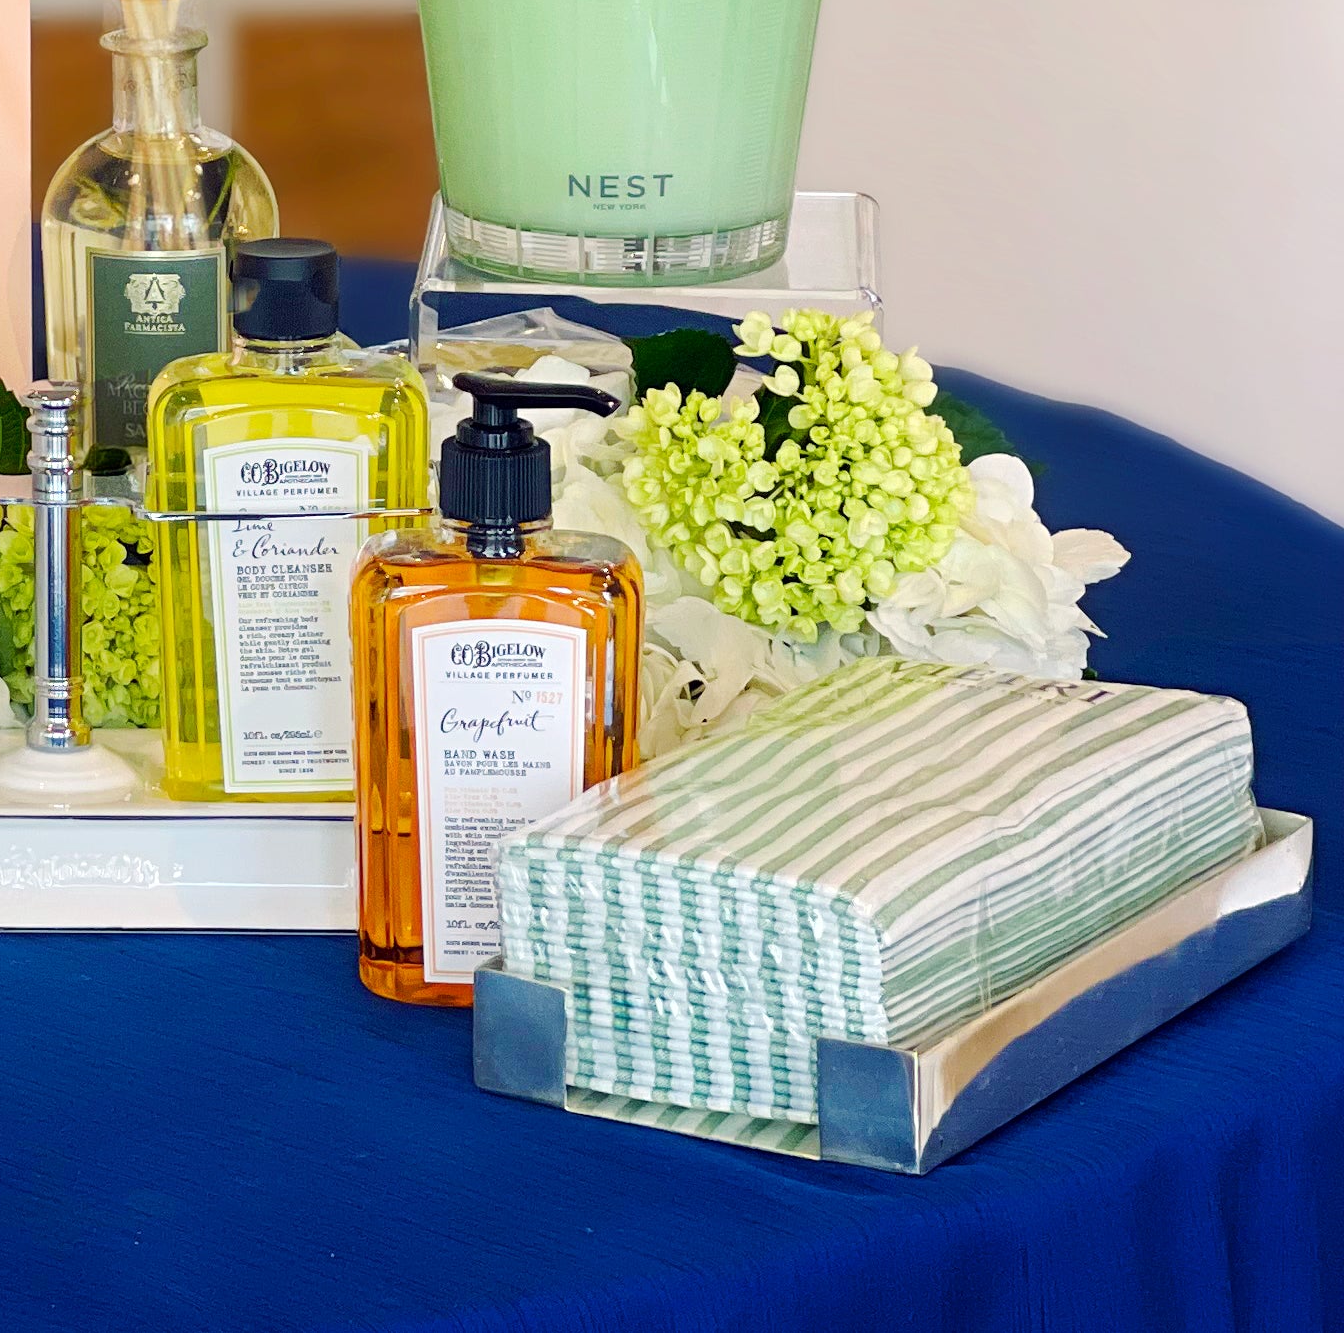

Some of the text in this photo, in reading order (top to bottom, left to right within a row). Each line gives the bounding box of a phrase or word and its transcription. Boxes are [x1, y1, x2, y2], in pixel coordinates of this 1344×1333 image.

[568, 174, 673, 198] NEST
[593, 203, 646, 211] NEW YORK
[135, 314, 174, 324] ANTICA
[124, 322, 186, 333] FARMACISTA
[236, 487, 339, 497] VILLAGE PERFUMER
[252, 533, 340, 559] Coriander
[237, 562, 333, 575] BODY CLEANSER
[238, 615, 319, 625] Our refreshing body
[274, 623, 308, 632] provides
[297, 630, 324, 638] lather
[445, 671, 553, 680] VILLAGE PERFUMER
[535, 691, 563, 704] 1527
[440, 707, 555, 744] Grapefruit
[444, 749, 516, 760] HAND WASH
[444, 760, 473, 768] SAVON
[502, 761, 519, 769] LES
[444, 768, 527, 777] AU PAMPLEMOUSSE
